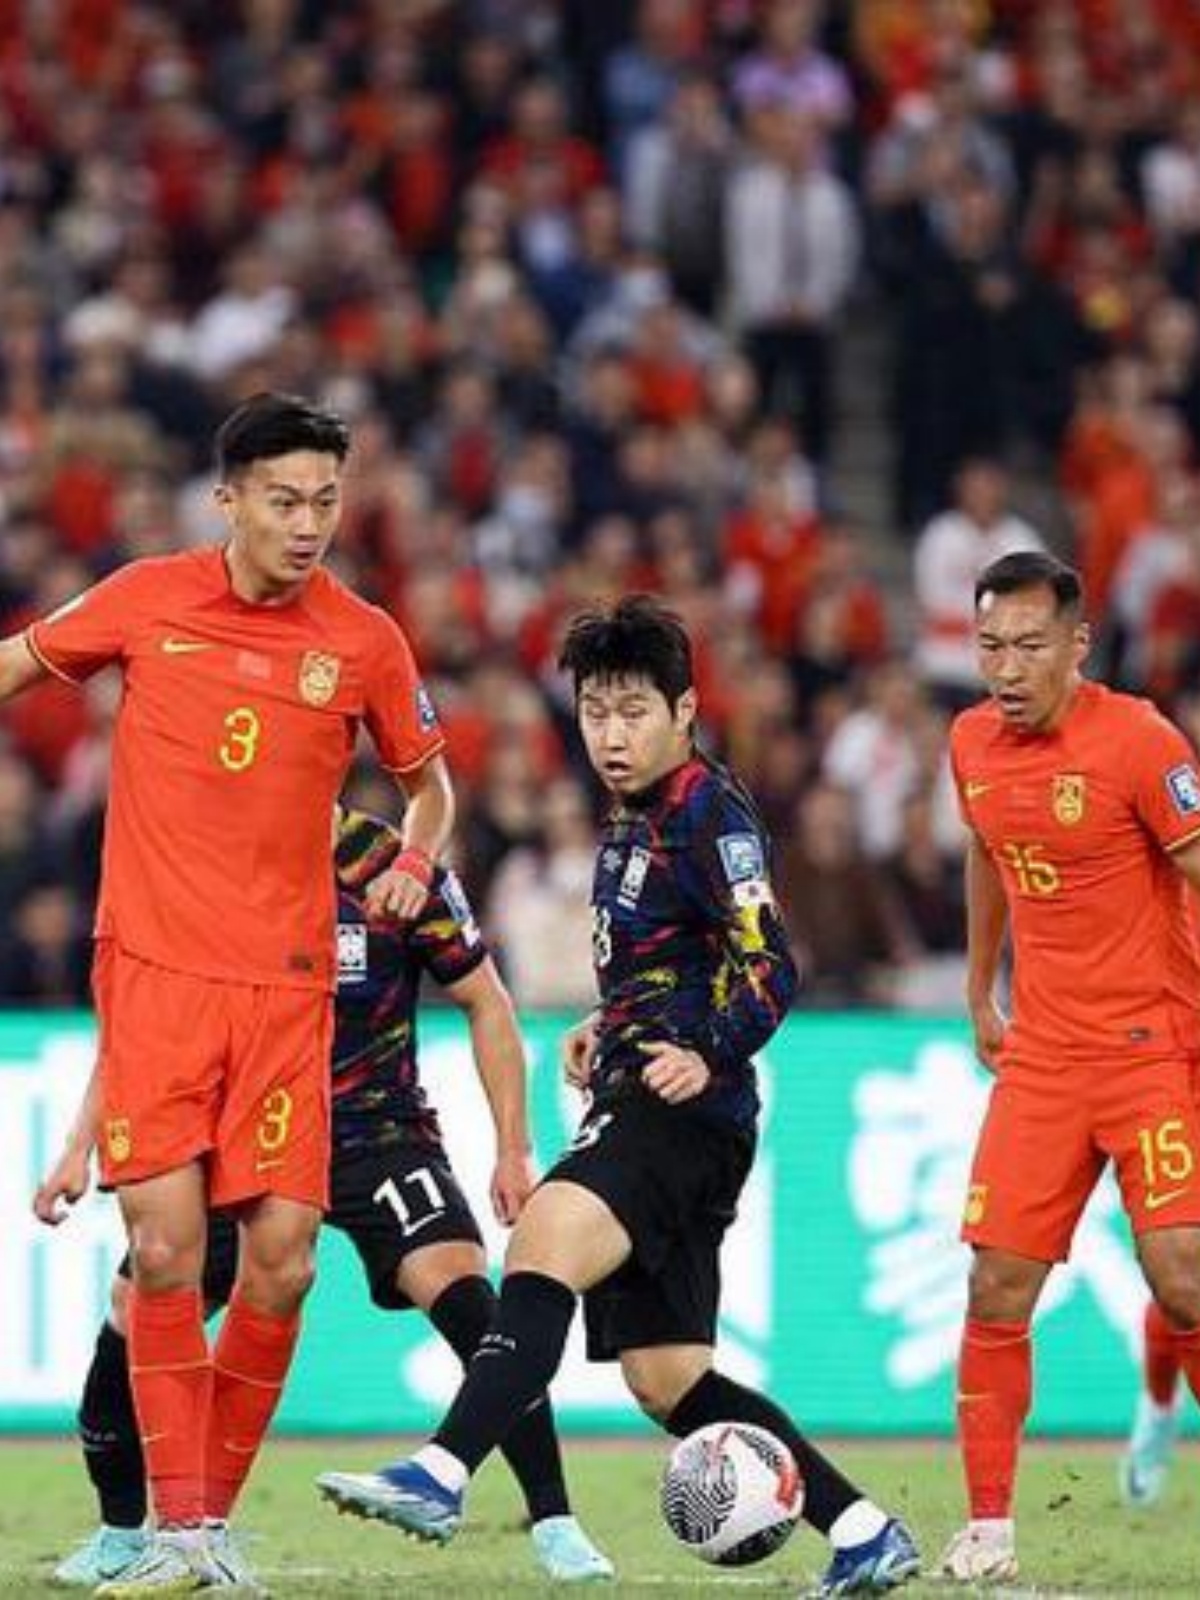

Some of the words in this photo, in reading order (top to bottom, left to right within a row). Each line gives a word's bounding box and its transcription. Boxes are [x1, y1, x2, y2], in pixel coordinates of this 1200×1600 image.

[220, 707, 260, 772] 3
[1002, 842, 1061, 895] 15
[258, 1088, 293, 1149] 3
[1137, 1120, 1193, 1184] 15
[372, 1167, 446, 1224] 11
